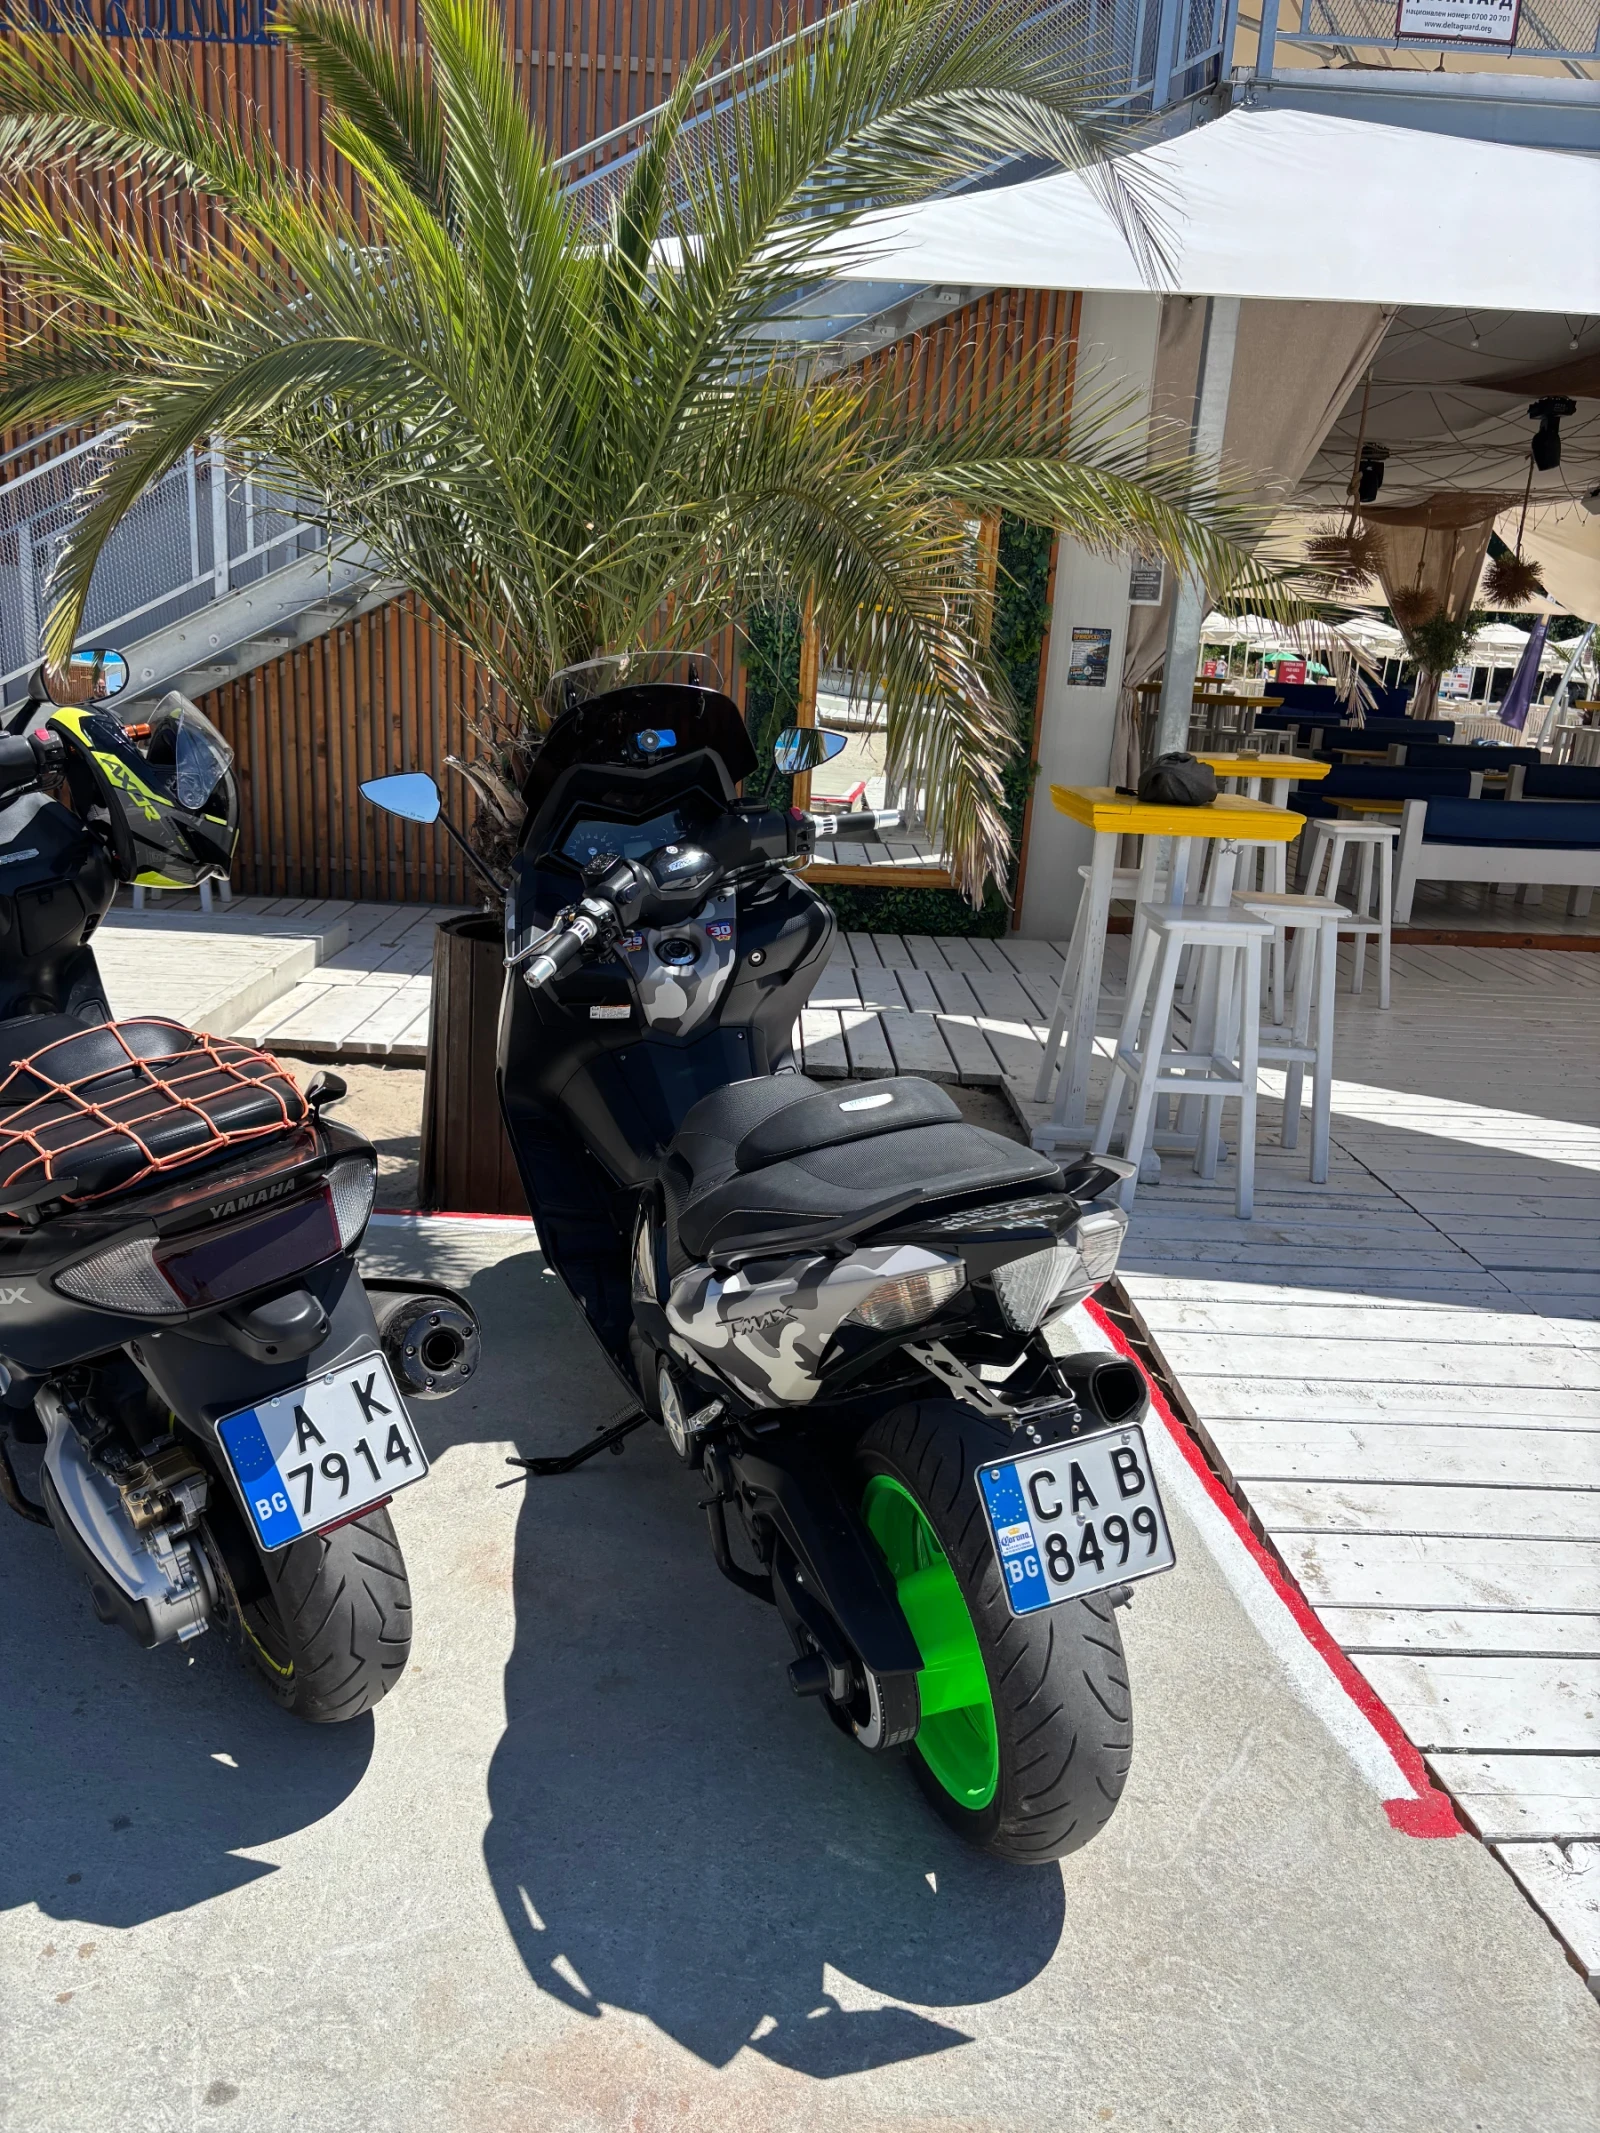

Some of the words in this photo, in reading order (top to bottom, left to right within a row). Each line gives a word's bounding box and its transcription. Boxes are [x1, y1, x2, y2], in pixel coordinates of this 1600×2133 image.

[1405, 8, 1447, 18] национален
[1447, 11, 1471, 20] номер:
[1471, 12, 1488, 21] 0700
[1488, 13, 1498, 22] 20
[1424, 20, 1493, 34] www.deltaguard.org
[100, 757, 161, 822] AXOR
[622, 936, 643, 947] 29
[710, 926, 731, 936] 30
[209, 1177, 296, 1220] YAMAHA
[293, 1404, 327, 1455] A
[351, 1371, 394, 1425] K
[285, 1421, 414, 1517] 7914
[1028, 1458, 1100, 1523] CA
[1109, 1446, 1147, 1501] B
[255, 1491, 289, 1522] BG
[1001, 1532, 1031, 1547] Corona
[1044, 1504, 1159, 1585] 8499
[1009, 1555, 1040, 1584] BG
